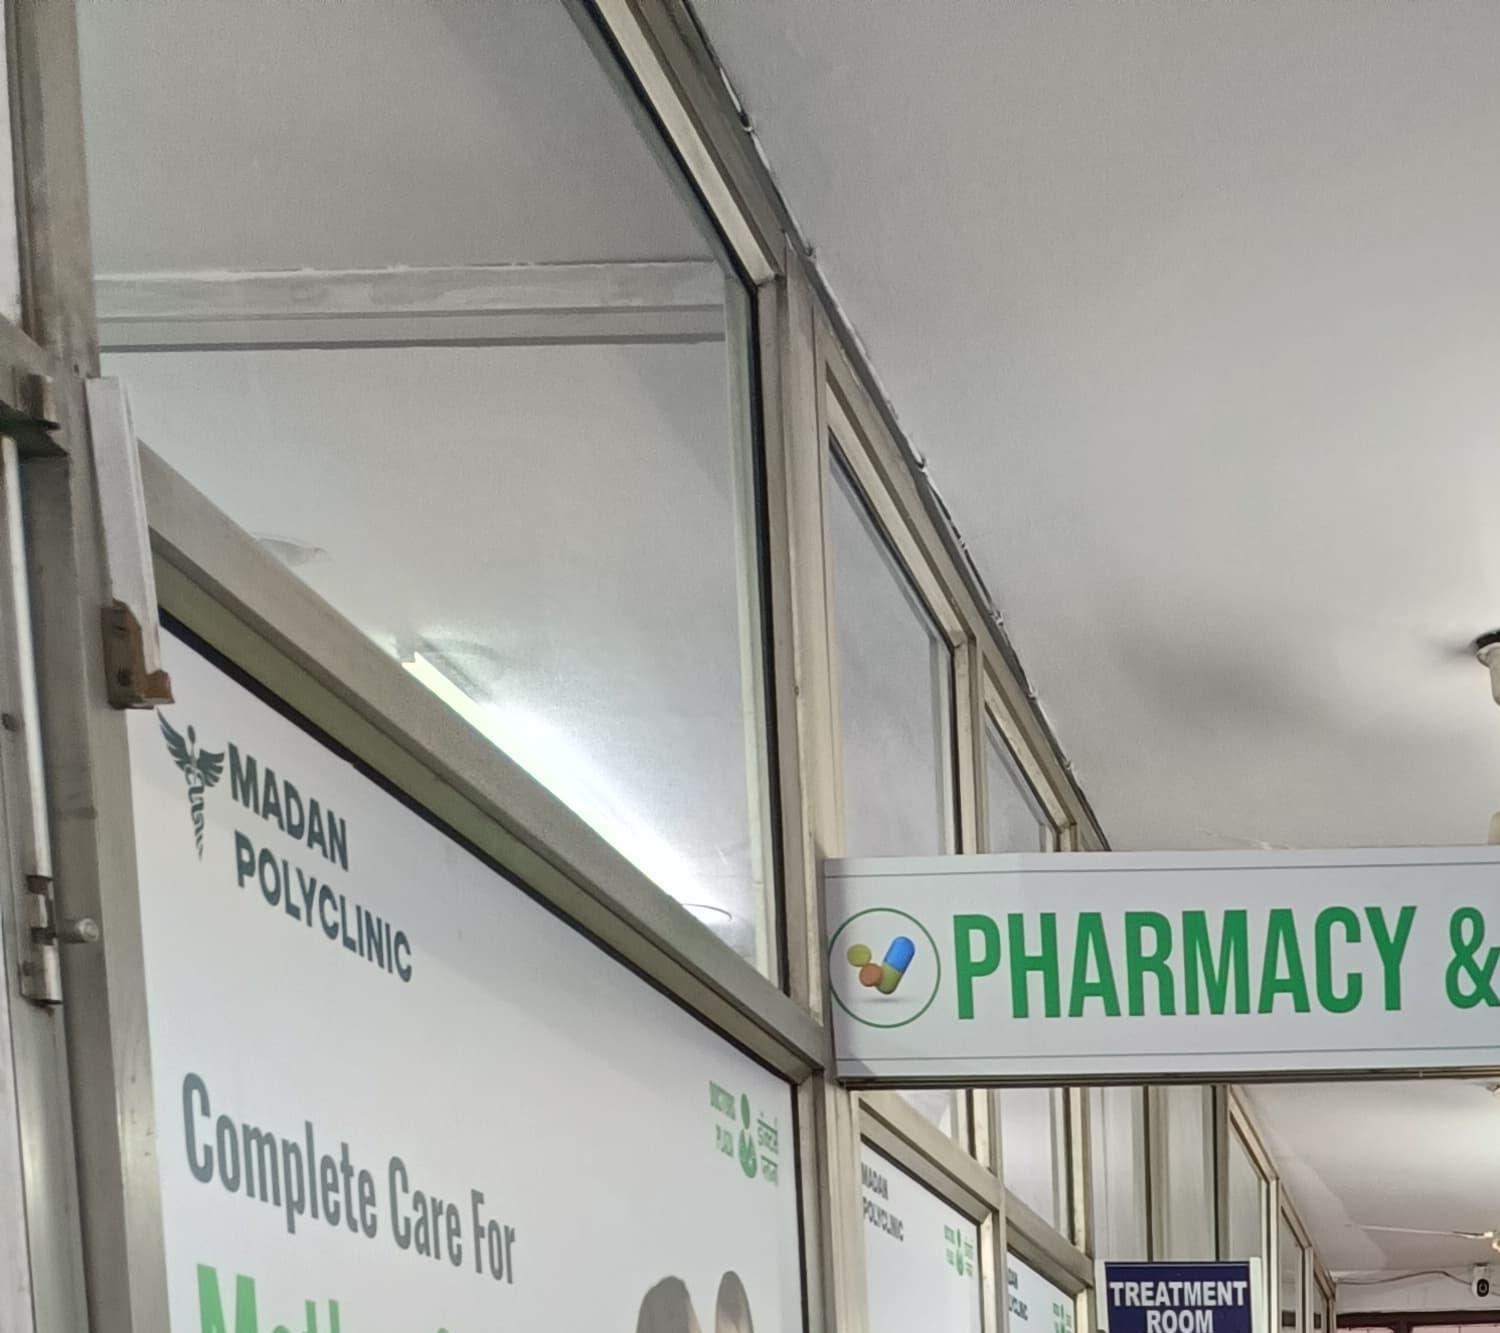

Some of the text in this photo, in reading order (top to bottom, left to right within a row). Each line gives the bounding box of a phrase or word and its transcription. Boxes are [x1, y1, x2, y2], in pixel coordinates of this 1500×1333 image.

[226, 743, 349, 872] MADAN
[233, 833, 413, 983] POLYCLINIC
[953, 905, 1417, 1020] PHARMACY
[181, 1072, 516, 1284] Complete Care For
[1110, 1281, 1247, 1307] TREATMENT
